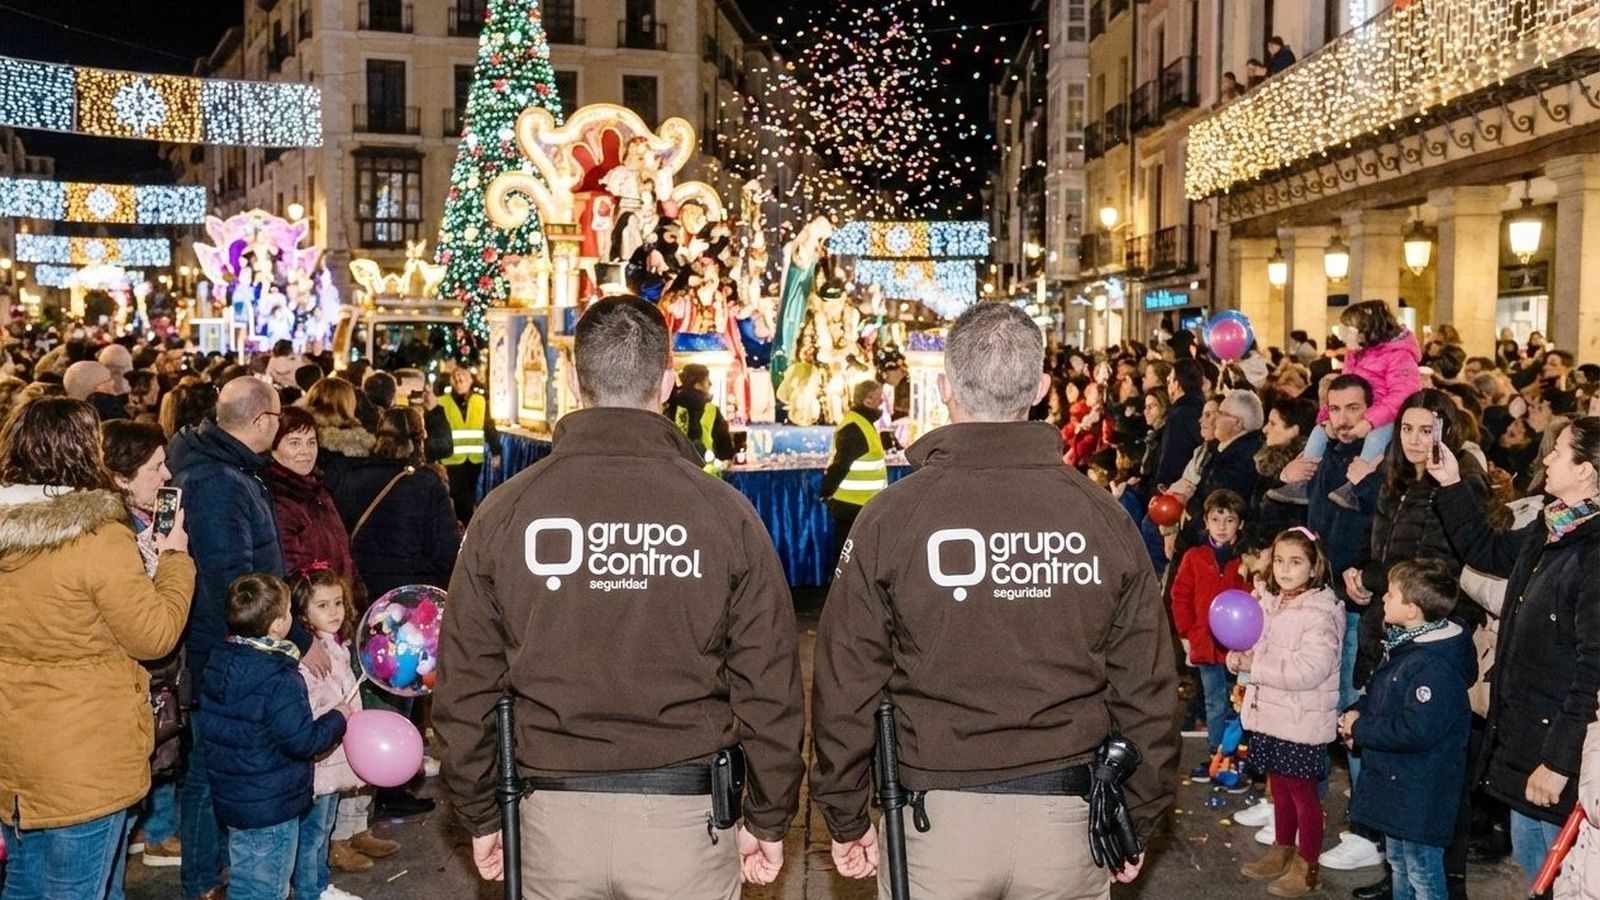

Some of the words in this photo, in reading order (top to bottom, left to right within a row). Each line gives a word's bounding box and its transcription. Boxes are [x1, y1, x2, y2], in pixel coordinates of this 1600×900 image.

[587, 522, 688, 552] grupo
[988, 531, 1087, 562] grupo
[588, 548, 703, 579] control
[990, 556, 1103, 586] control
[589, 578, 648, 593] seguridad
[993, 586, 1052, 601] seguridad
